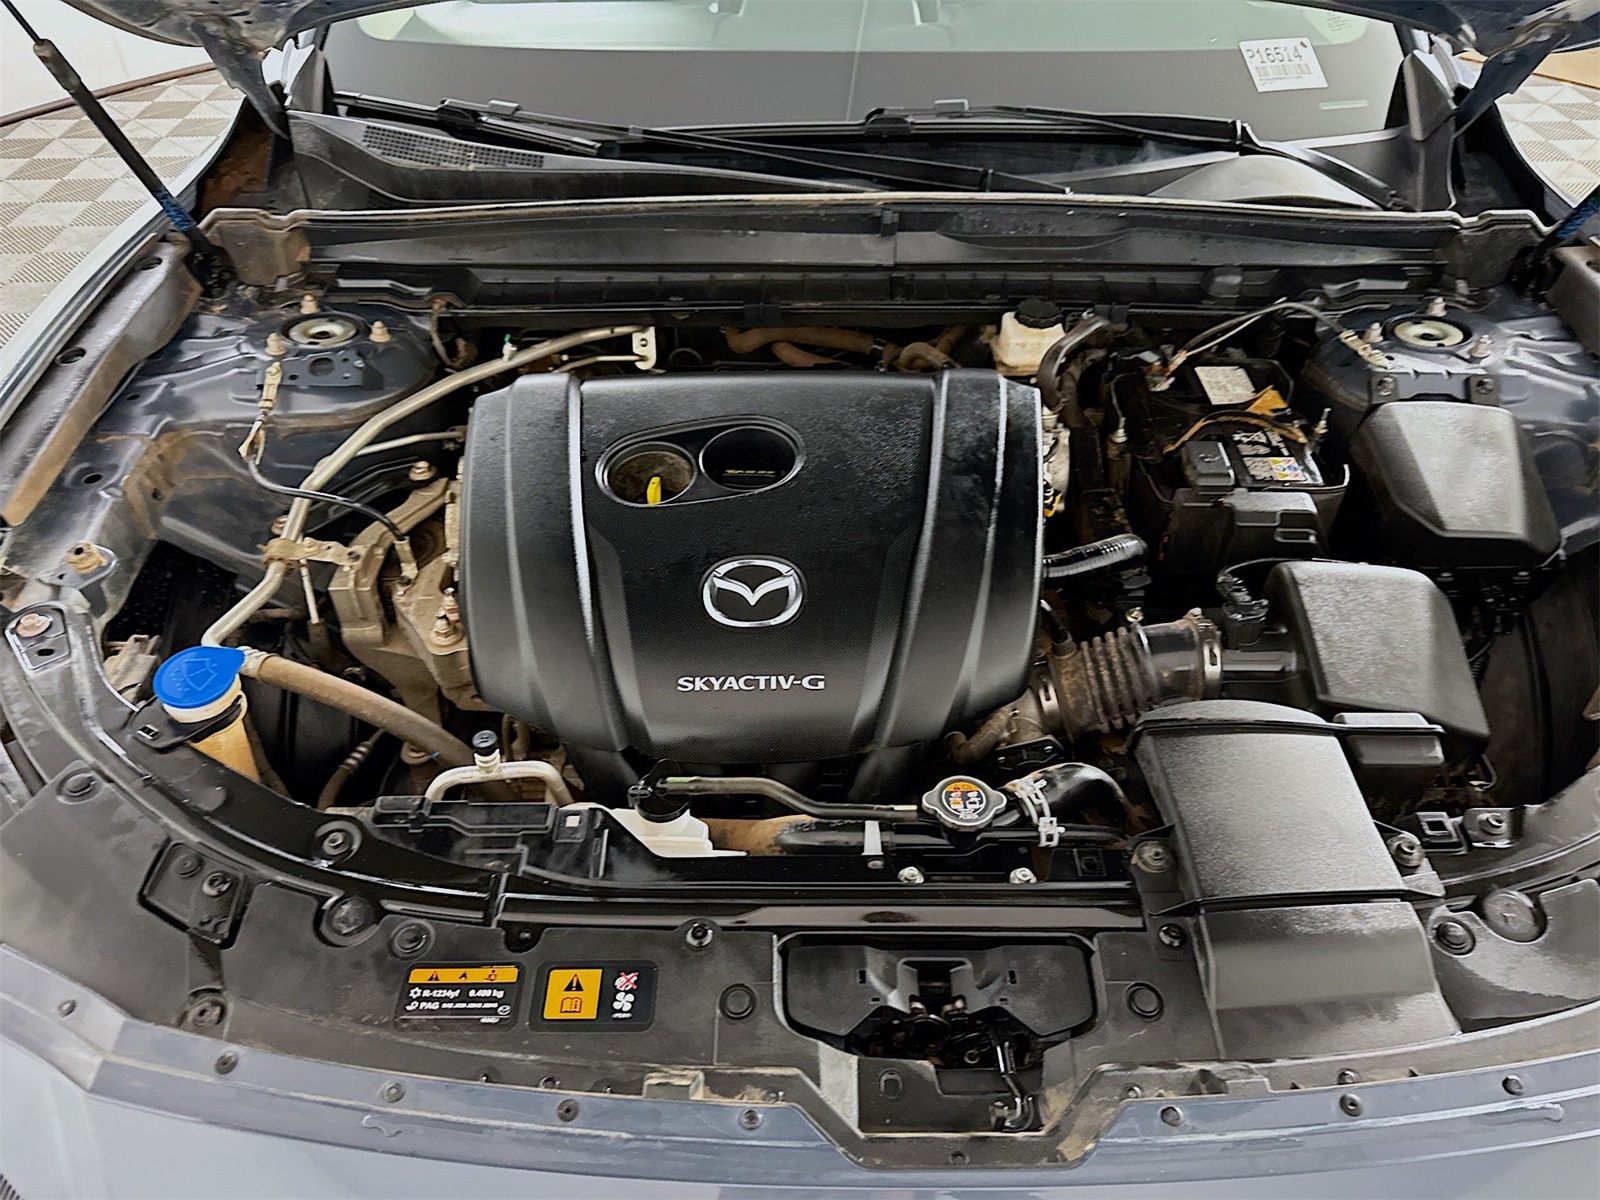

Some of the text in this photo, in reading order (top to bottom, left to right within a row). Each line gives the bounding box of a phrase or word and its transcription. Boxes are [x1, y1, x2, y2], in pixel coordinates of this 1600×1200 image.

[1245, 45, 1303, 64] P16514
[676, 675, 826, 692] SKYACTIV-G
[419, 1002, 440, 1010] PAG
